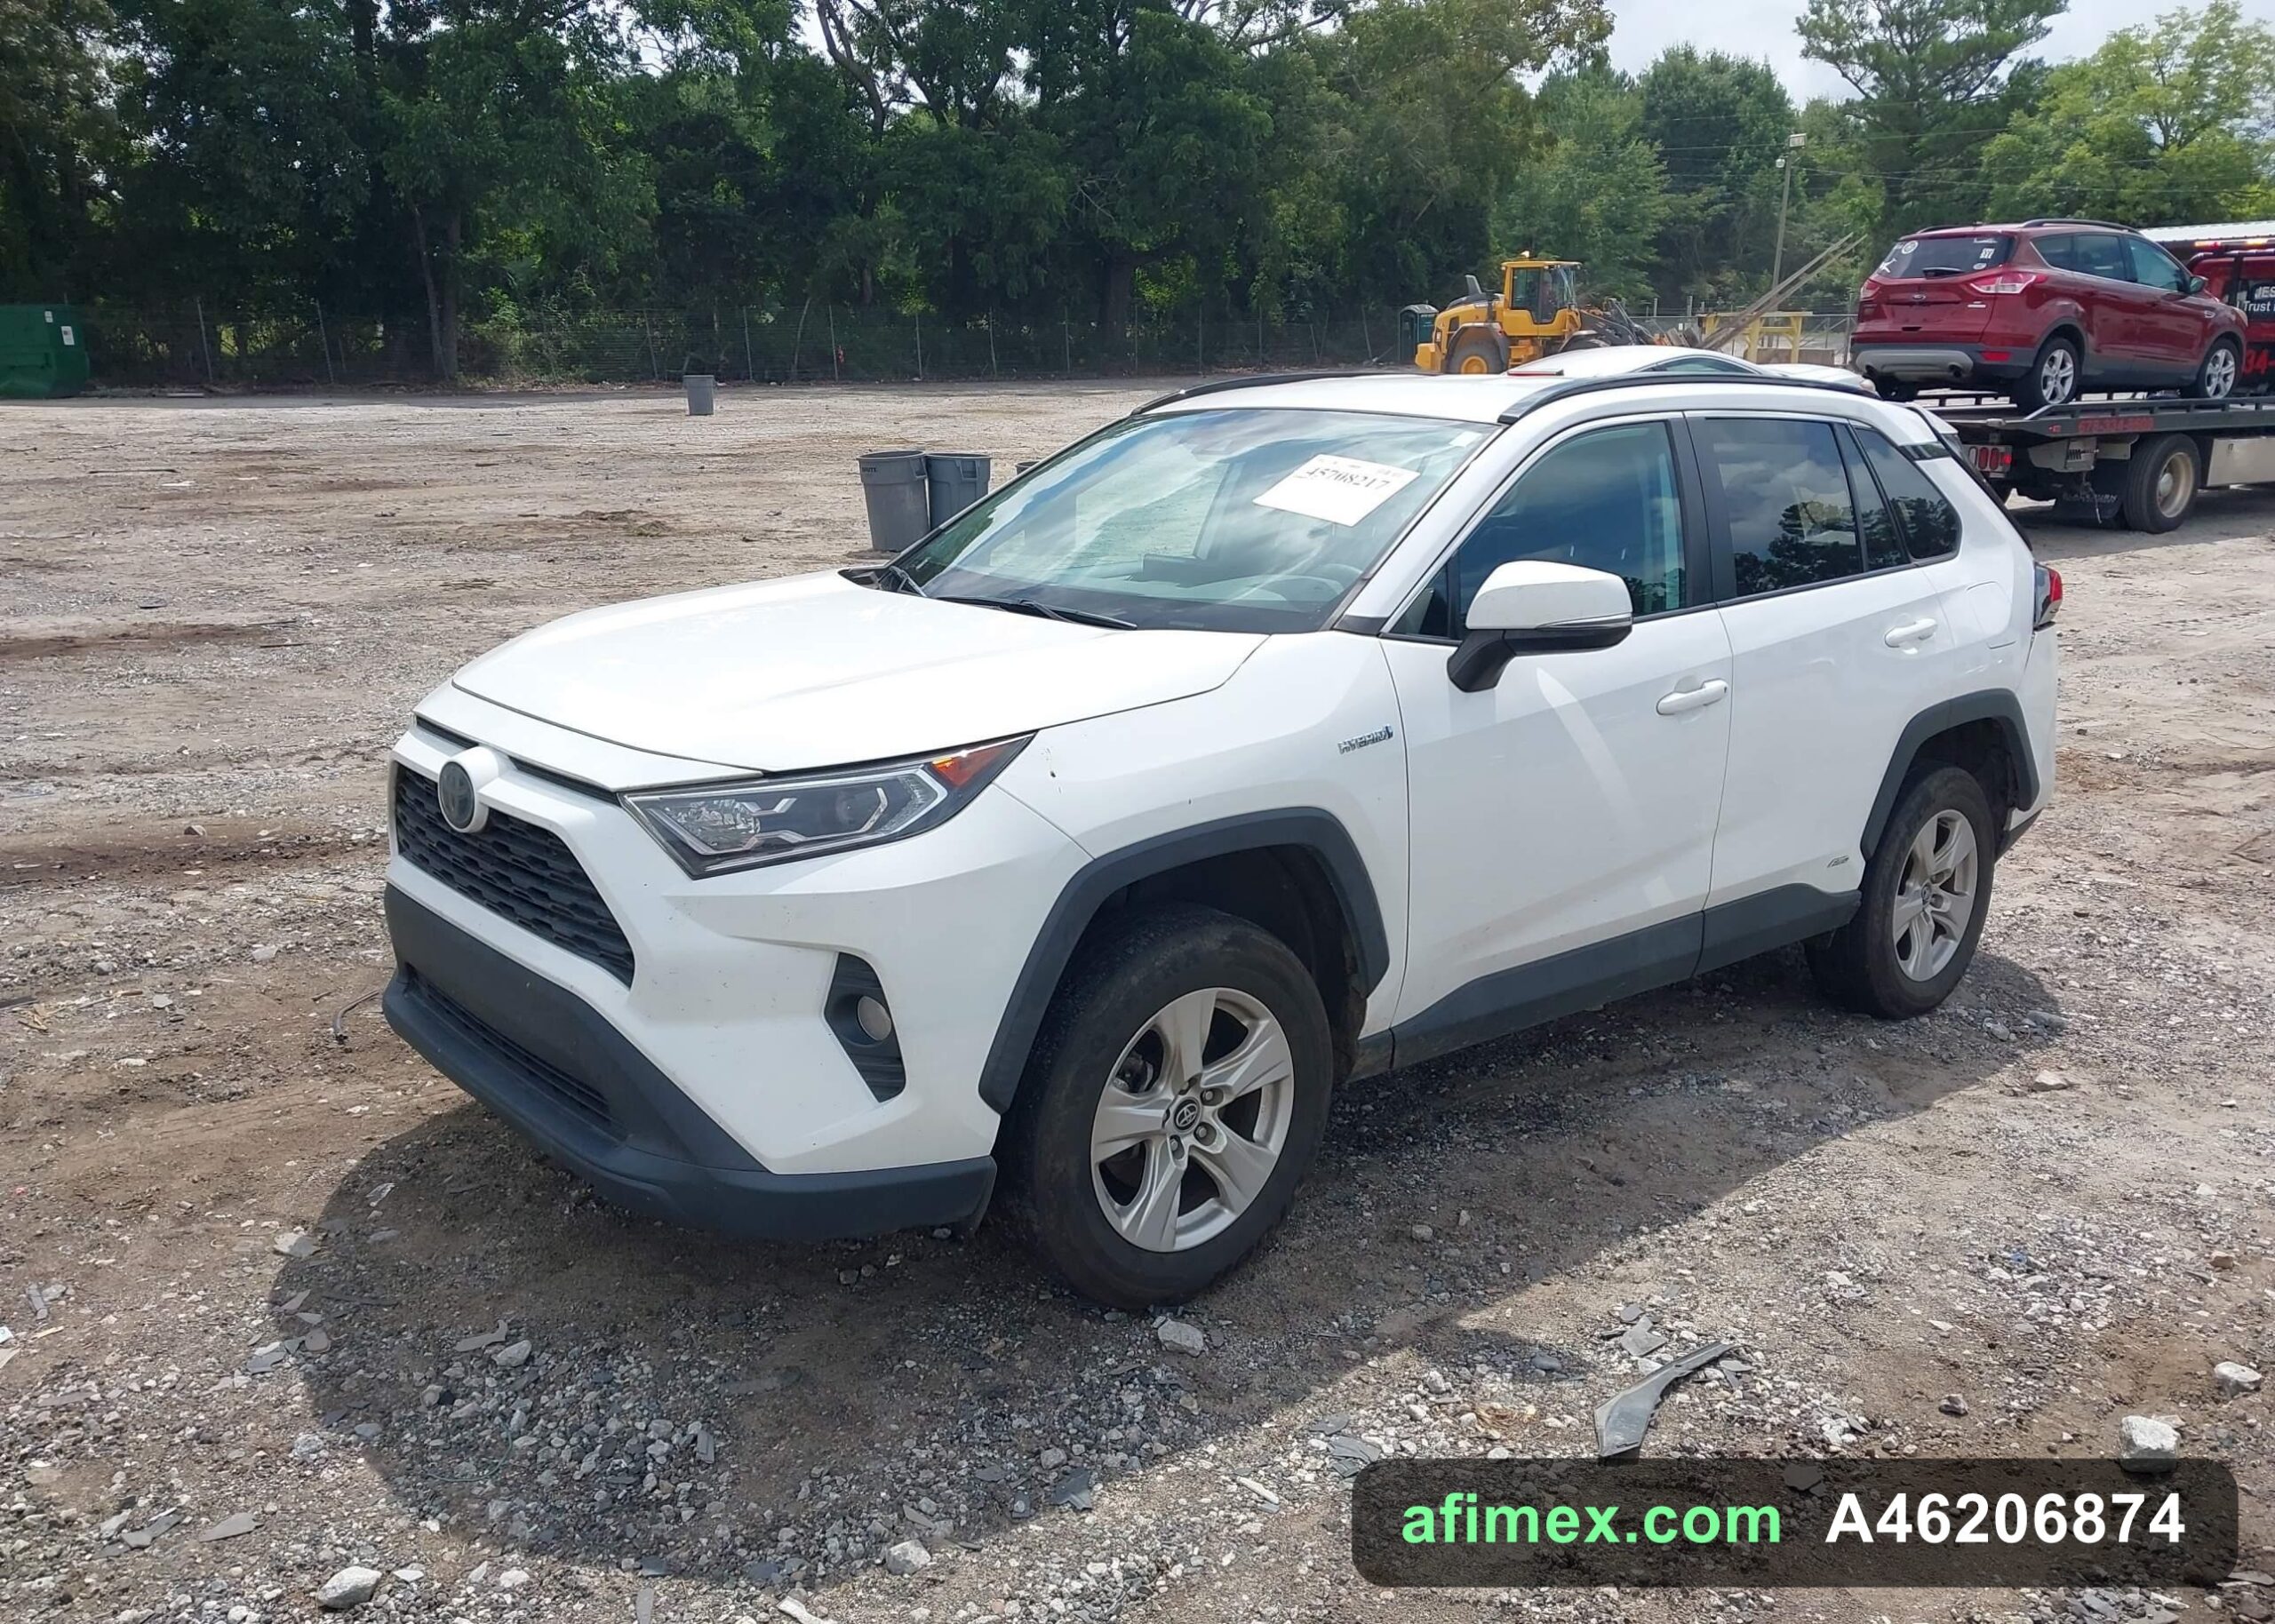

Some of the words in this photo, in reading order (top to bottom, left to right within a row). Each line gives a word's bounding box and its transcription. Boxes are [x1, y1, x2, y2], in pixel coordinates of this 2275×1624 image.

[2243, 299, 2271, 312] Trust
[1305, 467, 1390, 490] 45708217
[1337, 729, 1386, 754] HYBRID
